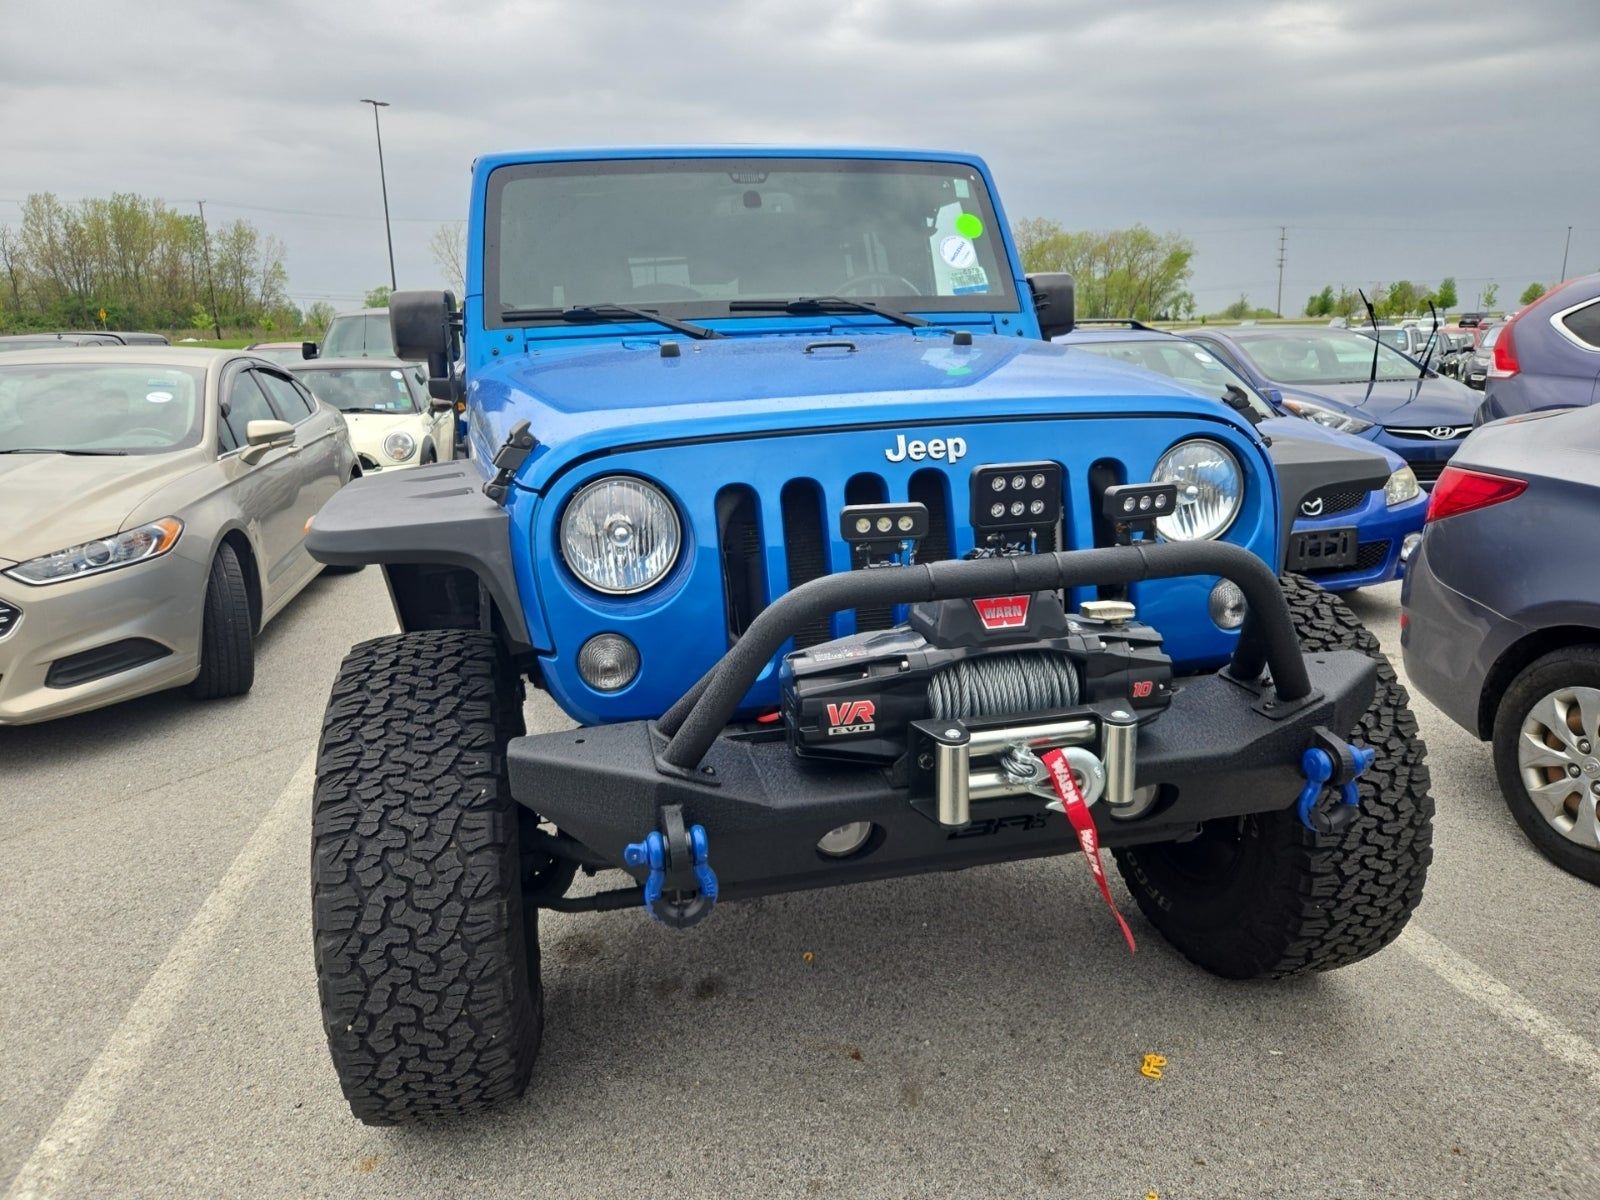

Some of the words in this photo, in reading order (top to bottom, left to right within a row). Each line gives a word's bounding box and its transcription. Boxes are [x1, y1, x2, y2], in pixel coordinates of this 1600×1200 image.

[885, 434, 967, 463] Jeep
[983, 605, 1022, 619] WARN
[1132, 681, 1153, 697] 10
[826, 700, 876, 726] VR
[832, 725, 871, 734] EVO
[1051, 756, 1080, 804] WARN
[1080, 828, 1102, 876] WARN
